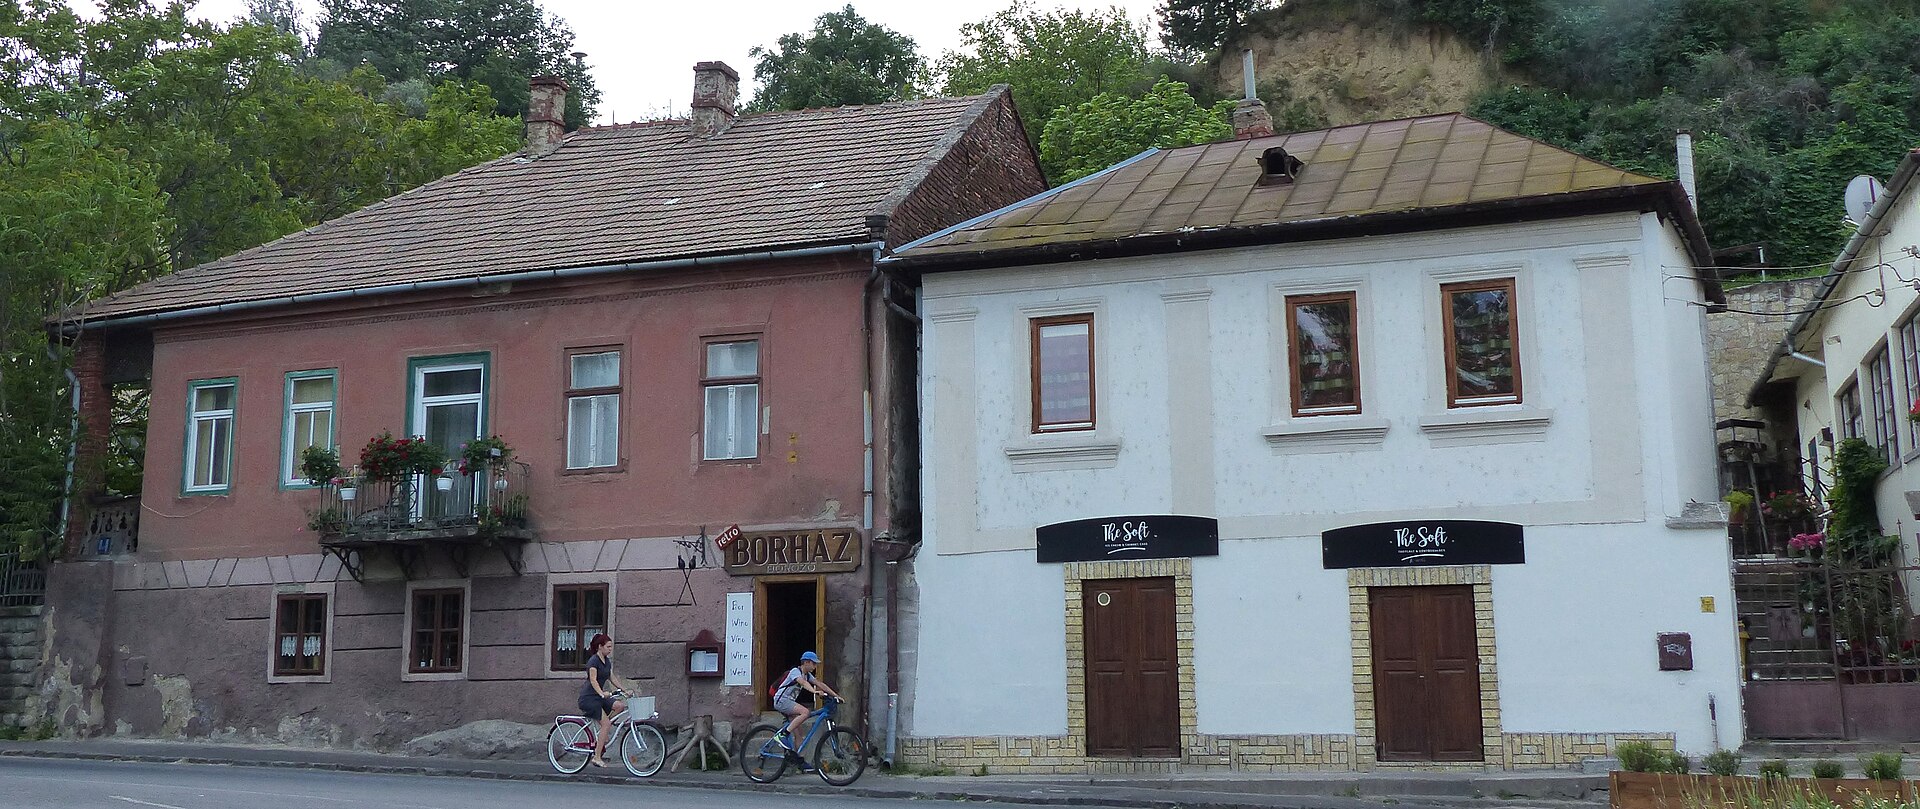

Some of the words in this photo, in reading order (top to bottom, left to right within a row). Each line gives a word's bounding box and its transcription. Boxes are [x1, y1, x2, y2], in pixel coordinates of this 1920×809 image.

[718, 527, 739, 547] retro
[1102, 523, 1121, 541] The
[1123, 521, 1150, 542] Soft
[1394, 528, 1416, 547] The
[1417, 526, 1448, 548] Soft
[731, 530, 853, 567] BORHÁZ
